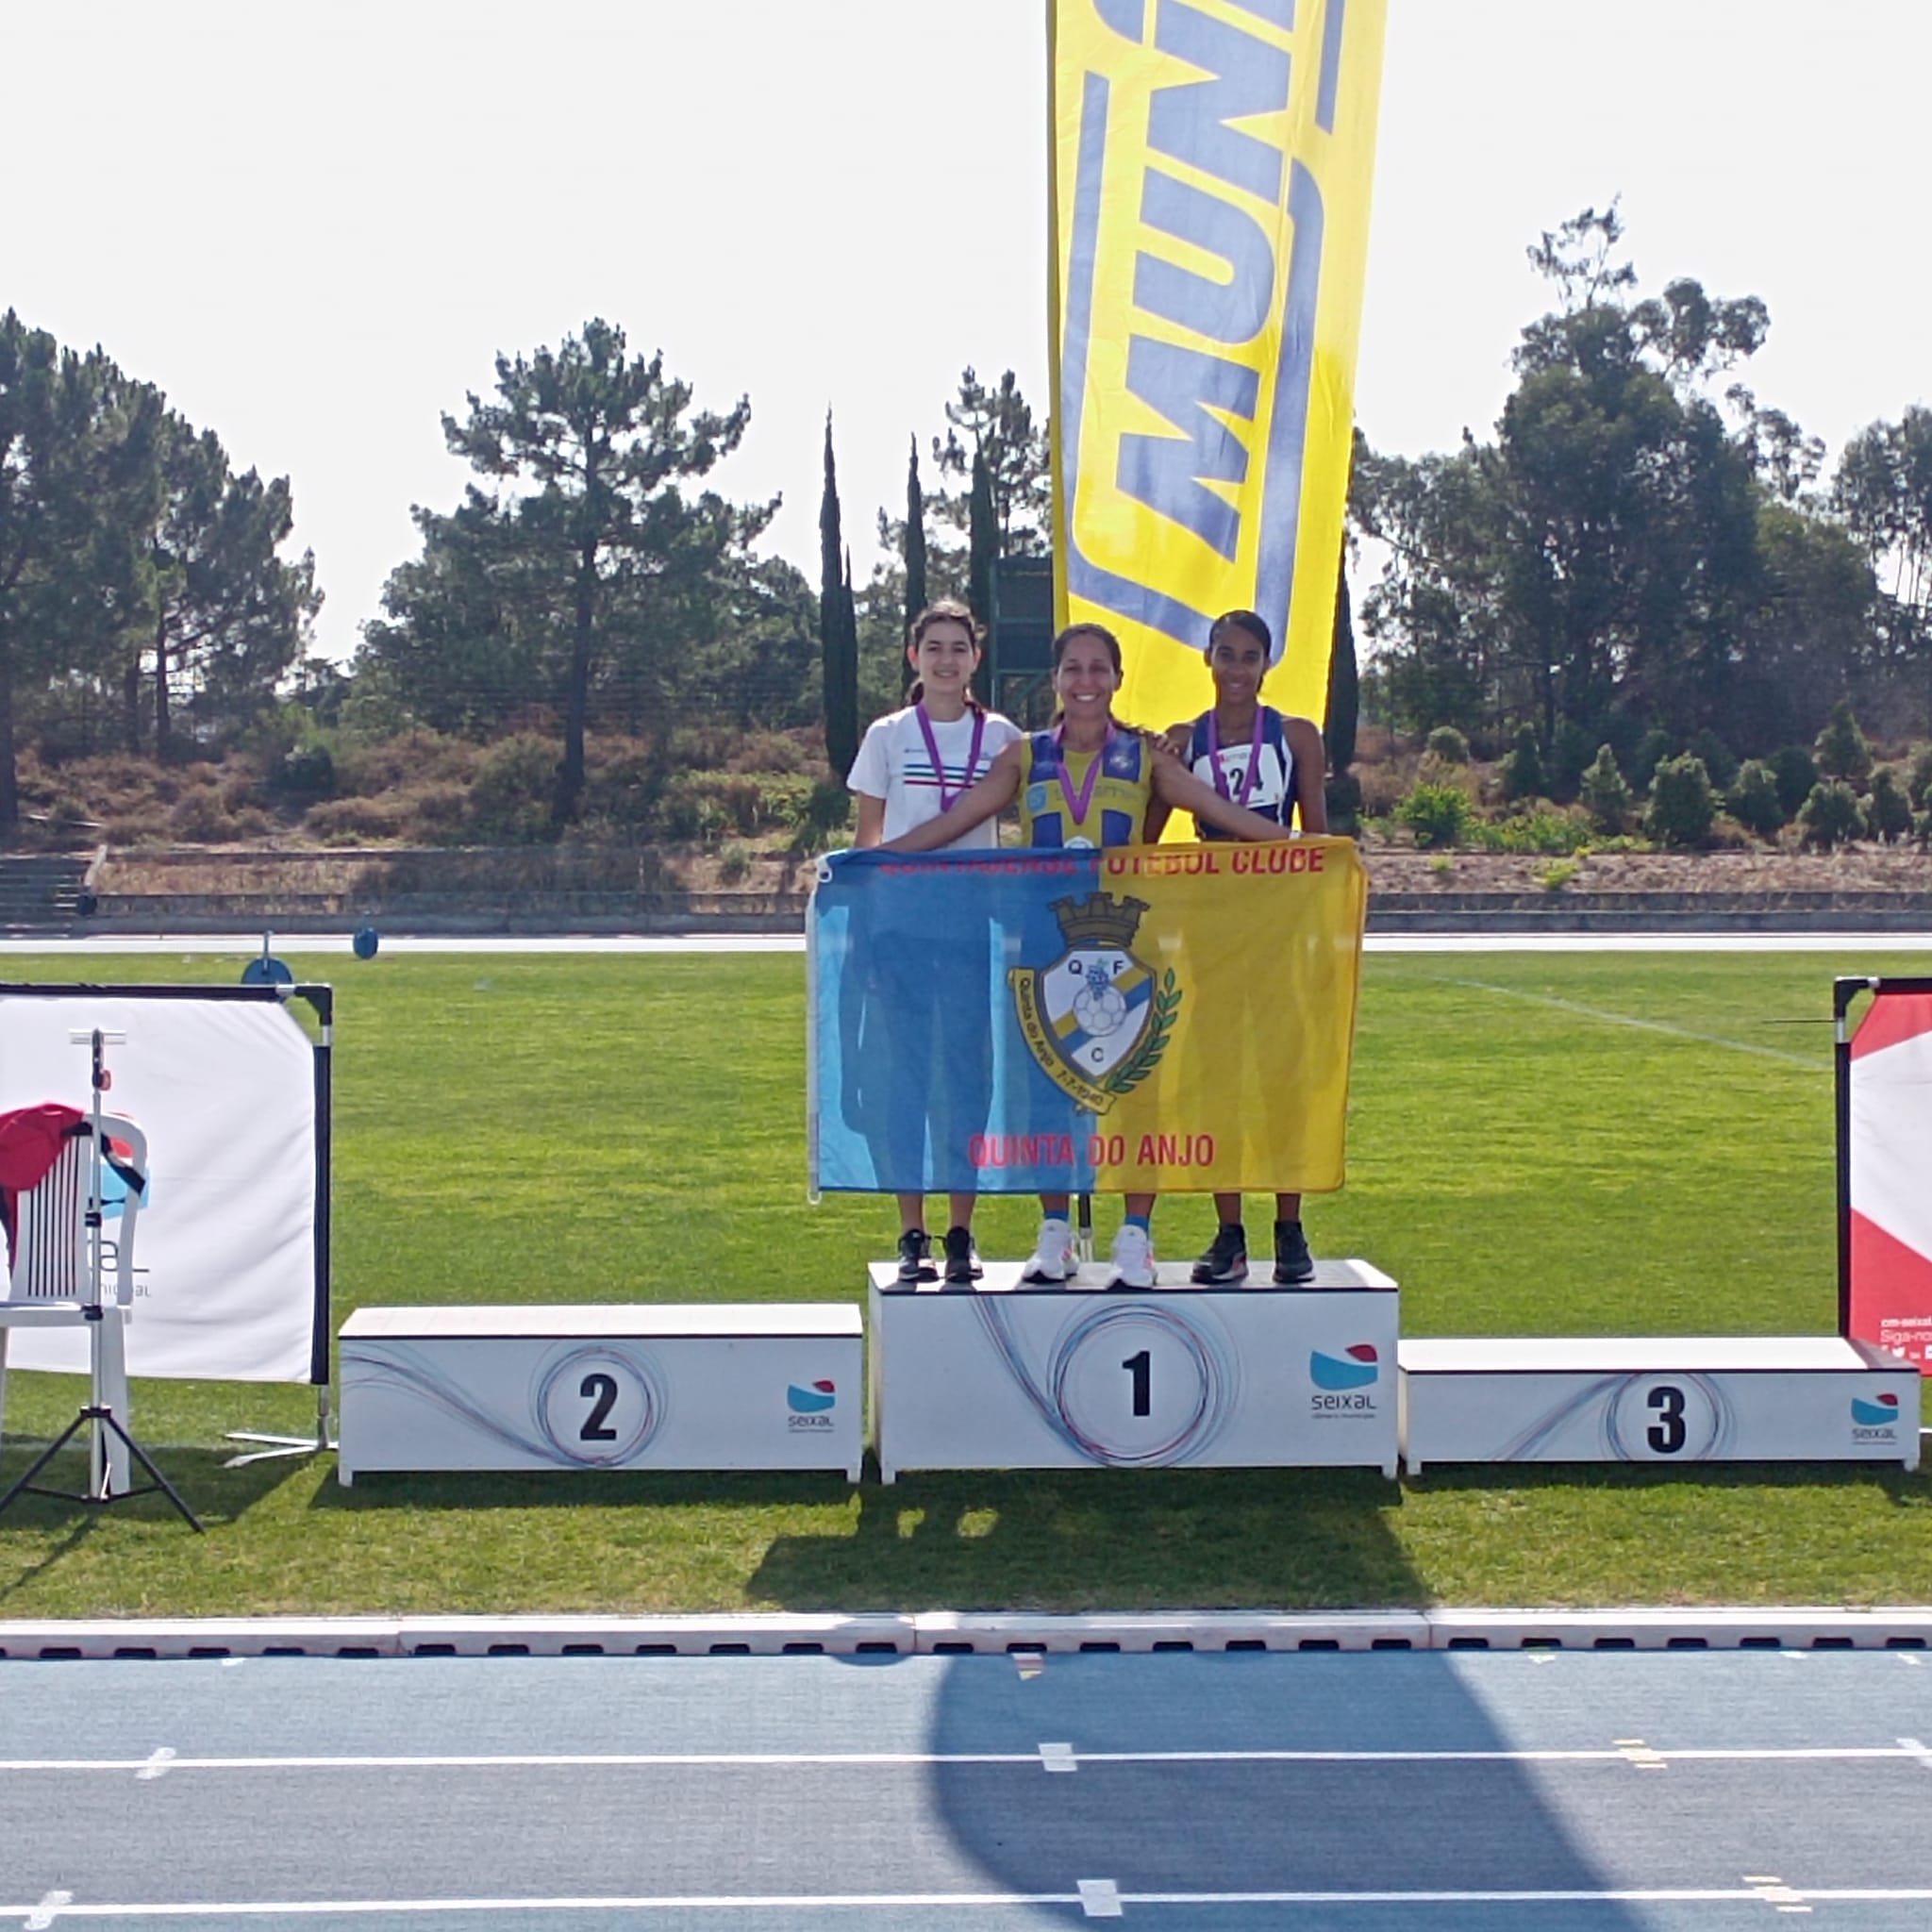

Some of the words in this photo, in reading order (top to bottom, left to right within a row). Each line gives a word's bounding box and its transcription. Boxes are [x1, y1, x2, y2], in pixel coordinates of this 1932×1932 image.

[1232, 847, 1325, 875] CLUBE
[1068, 959, 1083, 974] Q
[1113, 960, 1124, 974] F
[1091, 1047, 1104, 1062] C
[968, 1135, 1074, 1167] QUINTA
[1088, 1135, 1125, 1167] DO
[1137, 1134, 1215, 1167] ANJO
[1122, 1350, 1151, 1417] 1
[579, 1372, 619, 1441] 2
[1647, 1386, 1686, 1454] 3
